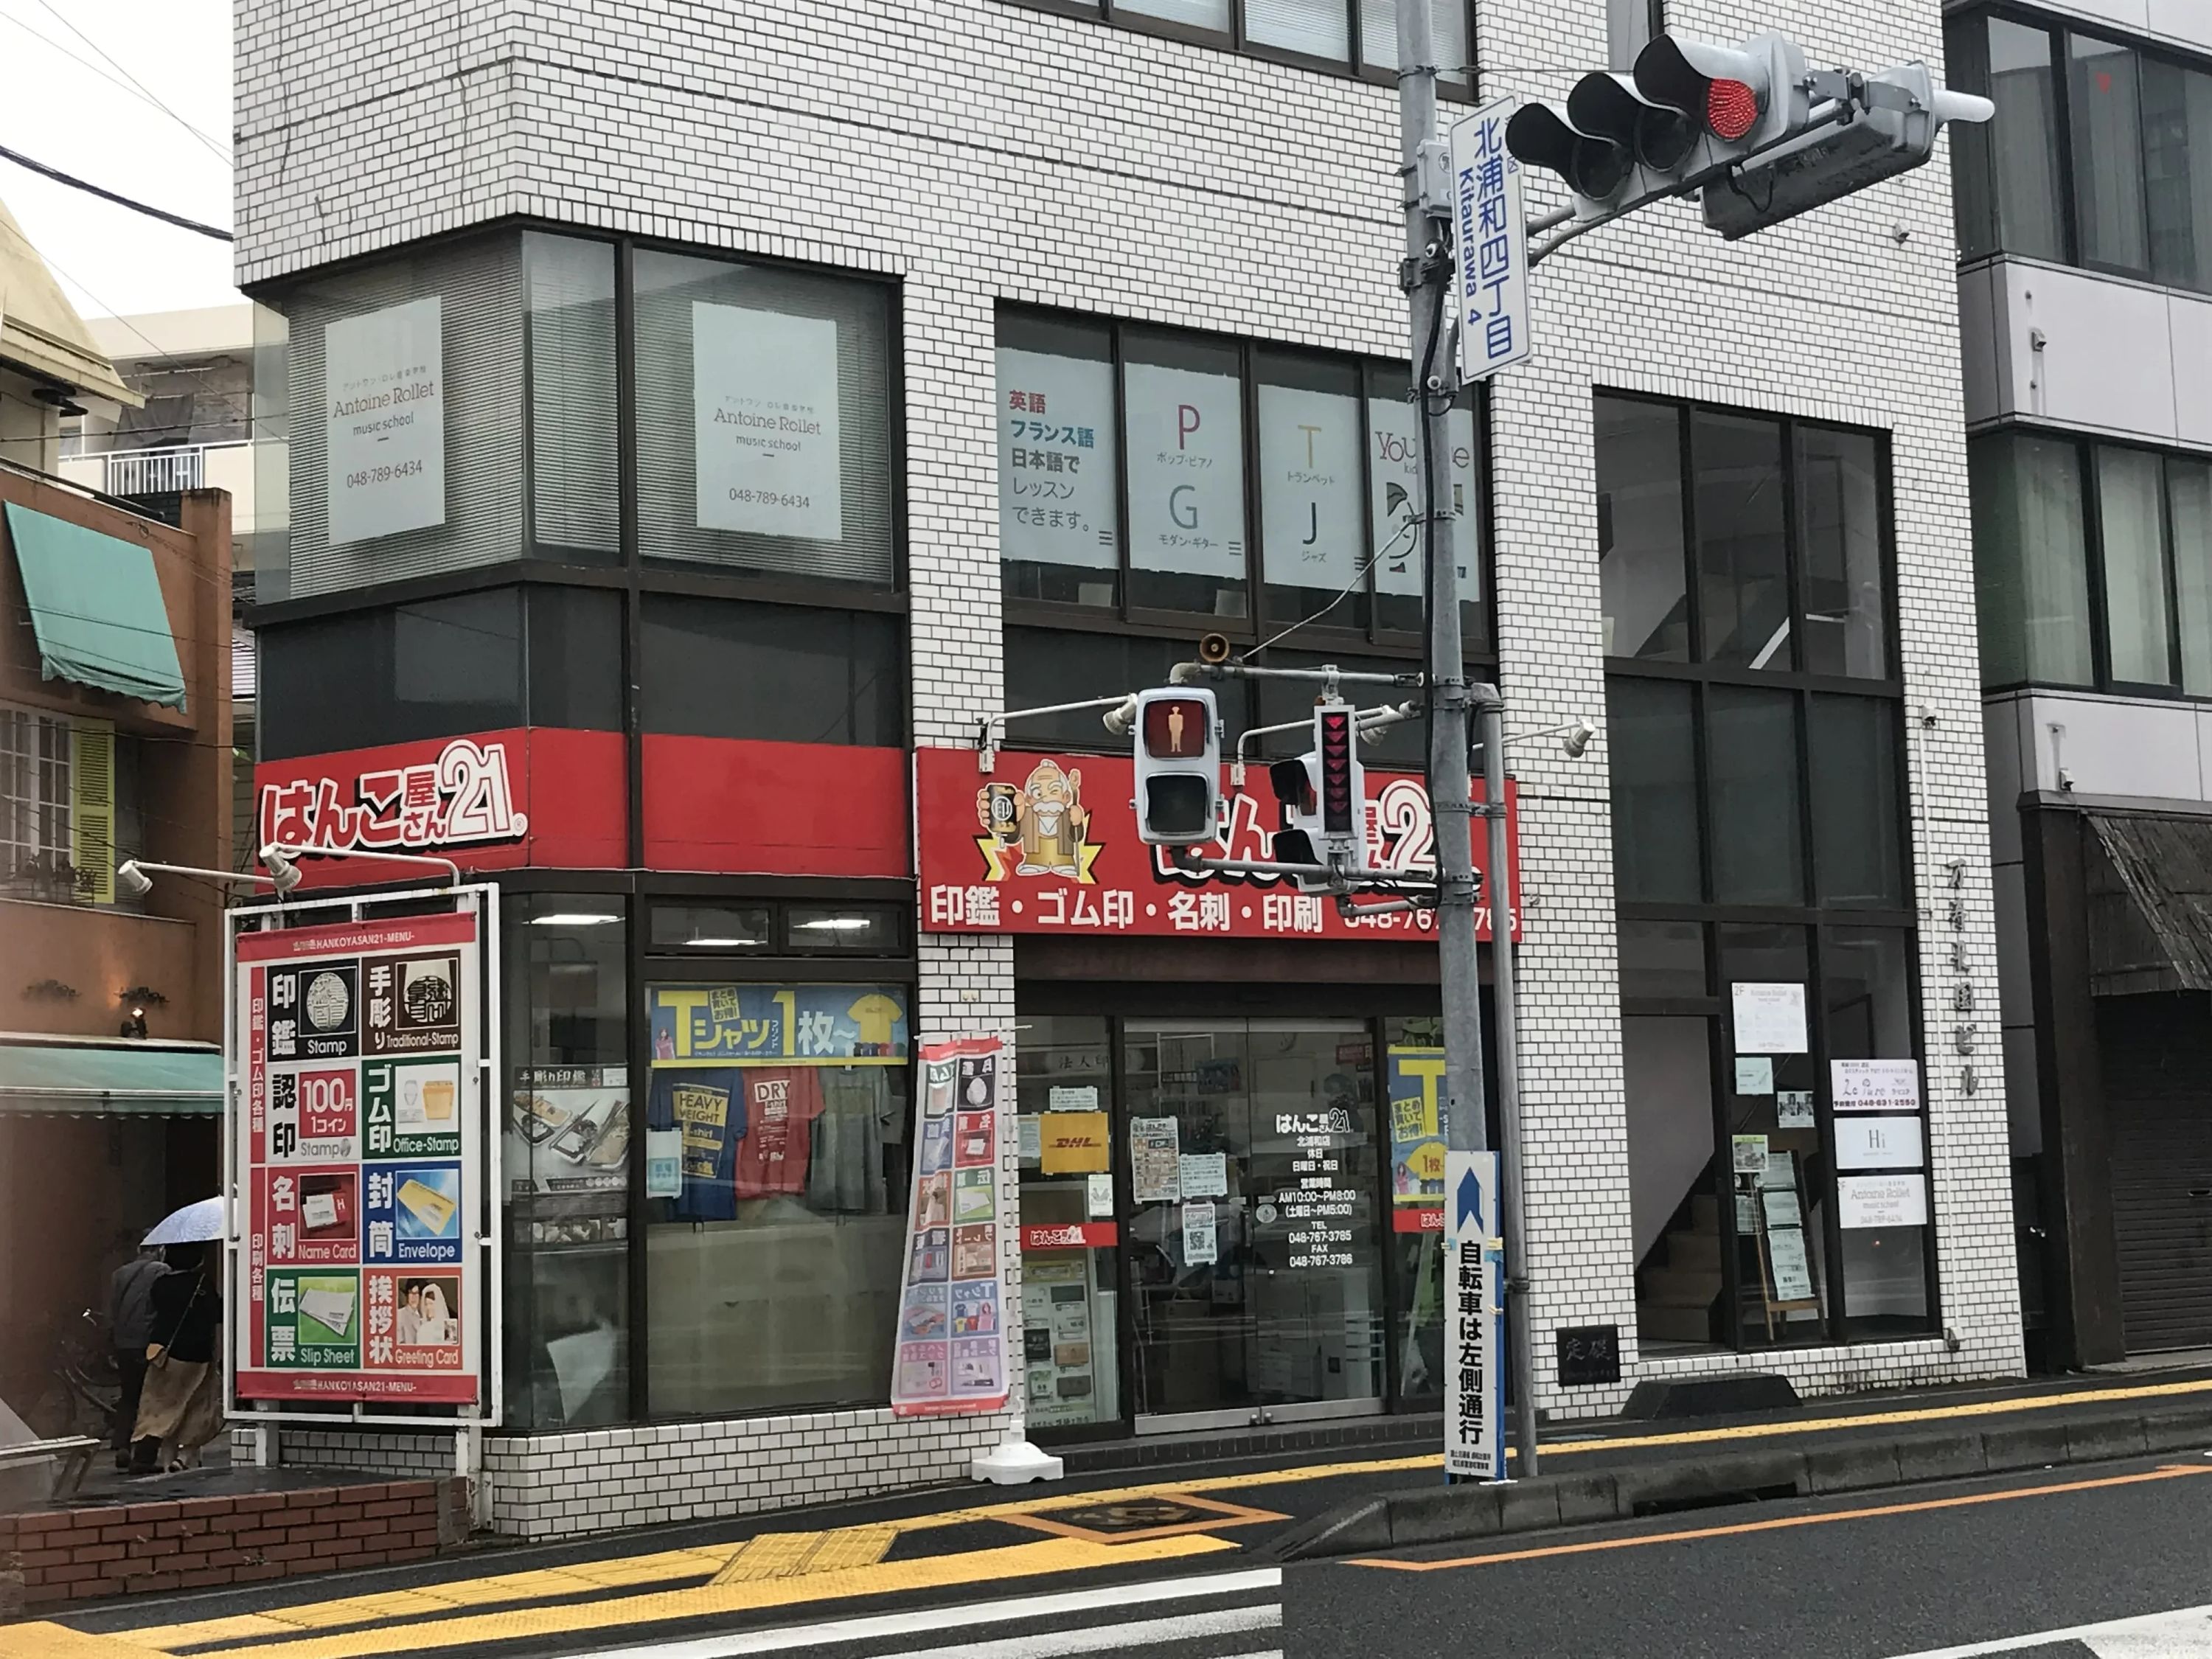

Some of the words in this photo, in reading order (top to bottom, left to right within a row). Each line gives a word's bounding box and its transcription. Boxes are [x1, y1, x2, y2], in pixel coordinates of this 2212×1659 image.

[1458, 167, 1478, 298] Kitaurawa
[1468, 308, 1482, 326] 4
[1474, 116, 1512, 359] 北浦和四丁目
[333, 393, 391, 418] Antoine
[393, 380, 434, 405] Rollet
[1009, 390, 1046, 414] 英語
[353, 420, 381, 436] music
[383, 411, 414, 430] school
[714, 408, 776, 429] Antoine
[779, 416, 821, 435] Rollet
[1179, 405, 1200, 451] P
[736, 435, 766, 448] music
[768, 439, 801, 451] school
[1010, 420, 1095, 449] フランス語
[1298, 425, 1322, 468] T
[347, 459, 422, 488] 048-789-6434
[1012, 448, 1082, 474] 日本語で
[729, 487, 810, 508] 048-789-6434
[1012, 480, 1075, 500] レッスン
[1169, 484, 1198, 529] G
[1012, 506, 1090, 533] できます。
[1302, 501, 1317, 546] J
[1301, 549, 1327, 563] ジャズ
[271, 973, 297, 1057] 印鑑
[369, 965, 392, 1050] 手彫り
[307, 1039, 347, 1056] Stamp
[386, 1032, 459, 1049] Traditional-Stamp
[303, 1077, 353, 1113] 100円
[680, 1093, 723, 1112] HEAVY
[757, 1082, 790, 1100] DRY
[272, 1074, 296, 1158] 認印
[368, 1064, 392, 1153] ゴム印
[310, 1116, 347, 1133] 1コイン
[301, 1141, 339, 1158] Stamp
[394, 1137, 459, 1156] Office-Stamp
[1297, 1135, 1331, 1147] 北浦和店
[1868, 1129, 1885, 1148] Hi
[1307, 1149, 1324, 1159] 休日
[271, 1175, 296, 1259] 名刺
[368, 1172, 394, 1259] 封筒
[1311, 1221, 1327, 1230] TEL
[298, 1245, 330, 1259] Name
[333, 1244, 357, 1259] Card
[398, 1242, 455, 1262] Envelope
[1311, 1244, 1328, 1253] FAX
[271, 1278, 296, 1363] 伝票
[369, 1275, 394, 1365] 挨拶状
[1458, 1240, 1484, 1445] 自転車は左側通行
[301, 1348, 322, 1366] Slip
[324, 1349, 355, 1364] Sheet
[395, 1349, 434, 1368] Greeting
[437, 1349, 459, 1365] Card
